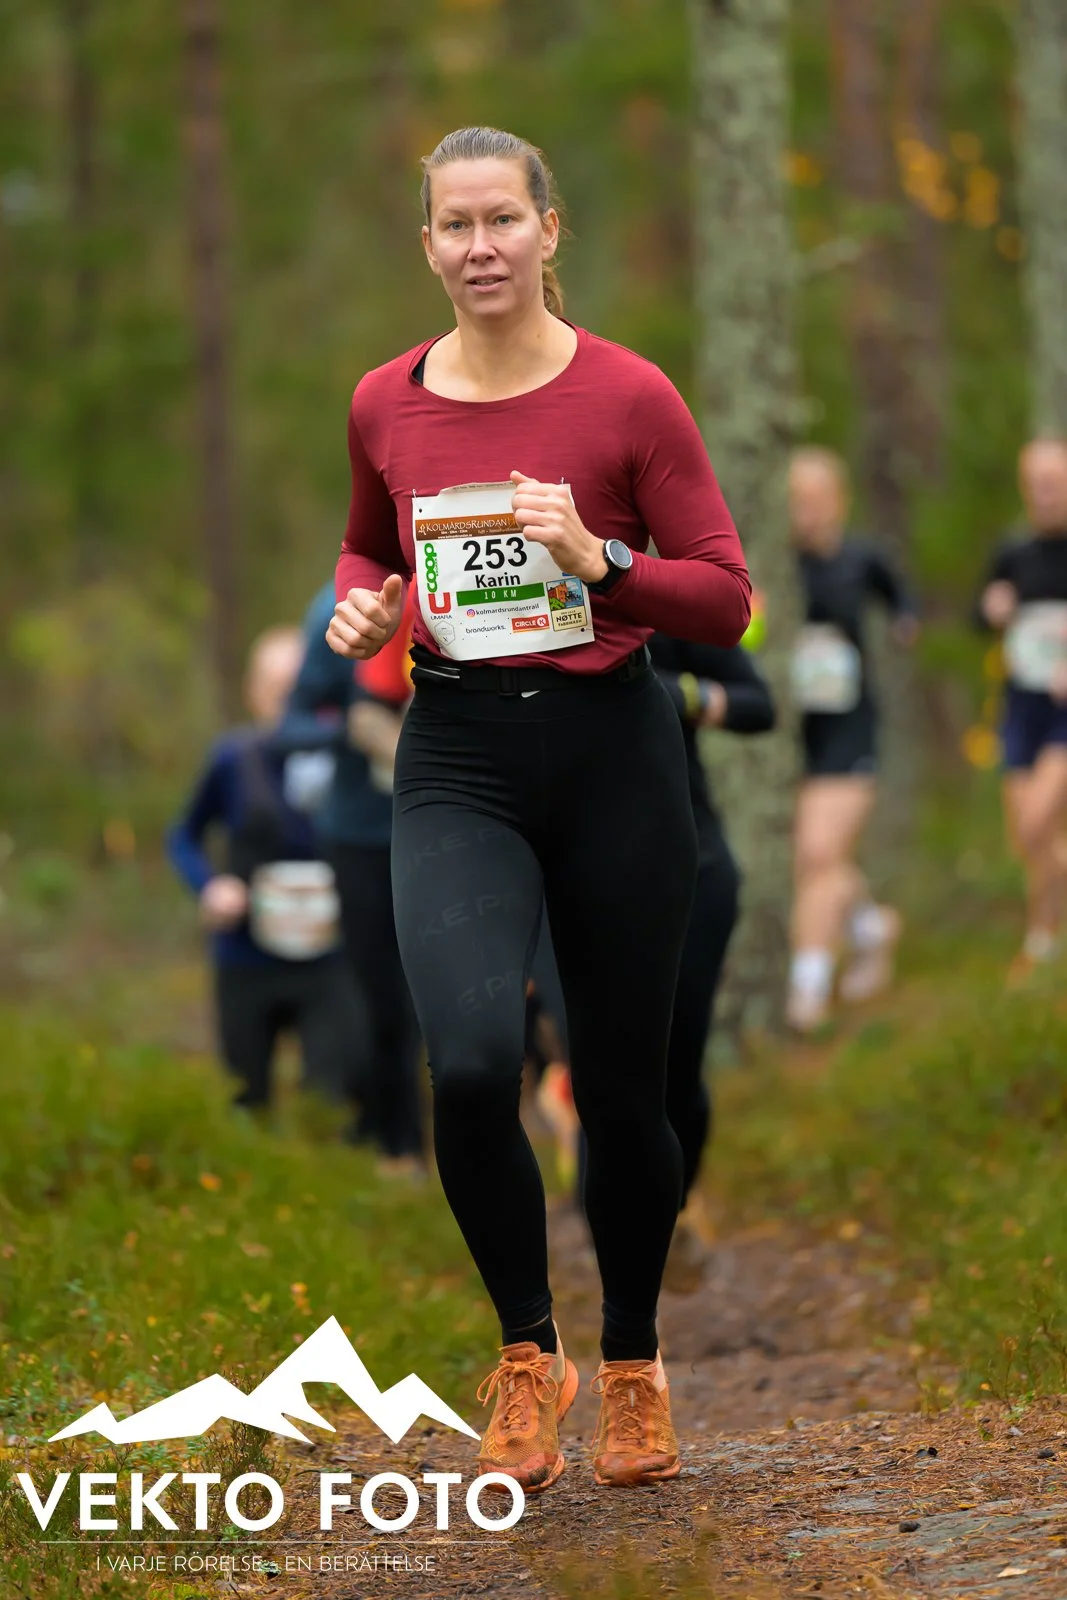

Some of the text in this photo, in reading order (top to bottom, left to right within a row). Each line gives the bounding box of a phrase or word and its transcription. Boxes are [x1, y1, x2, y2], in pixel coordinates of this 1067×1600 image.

[462, 536, 527, 571] 253
[424, 543, 438, 593] coop
[475, 572, 521, 588] Karin
[484, 589, 517, 600] 10 KM
[514, 619, 537, 628] CIRCLE
[556, 612, 582, 622] NØTTE
